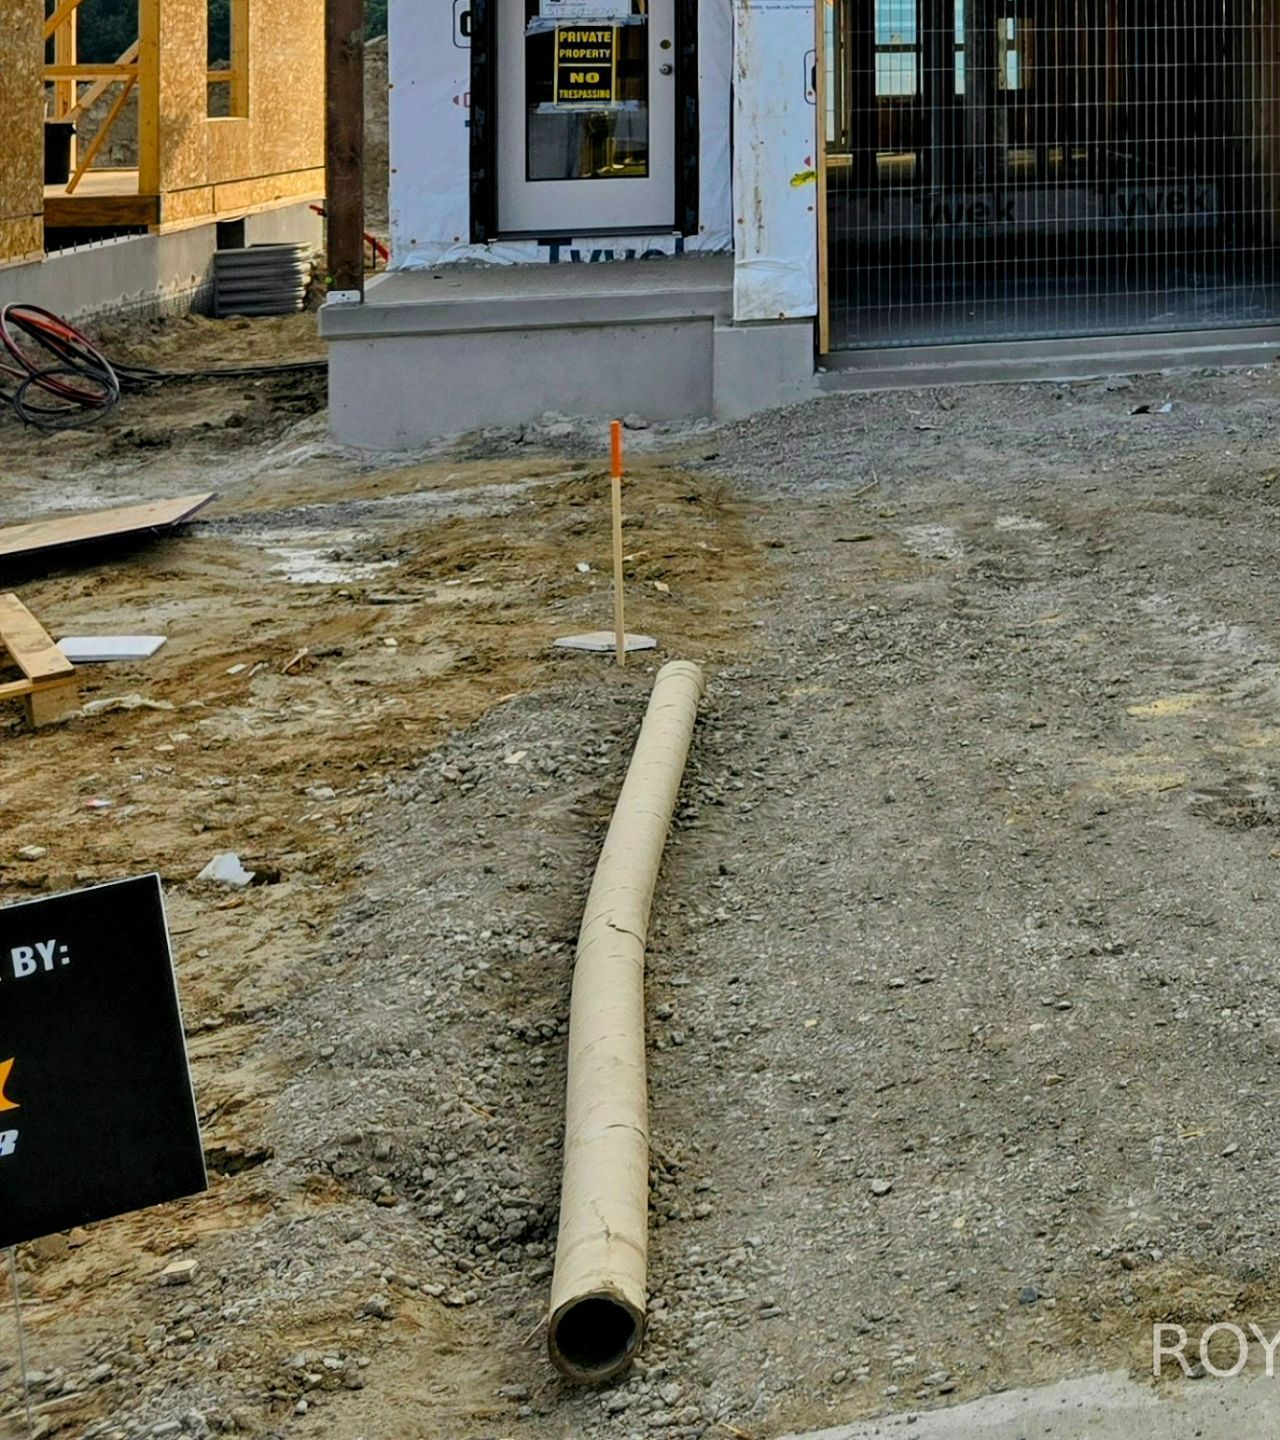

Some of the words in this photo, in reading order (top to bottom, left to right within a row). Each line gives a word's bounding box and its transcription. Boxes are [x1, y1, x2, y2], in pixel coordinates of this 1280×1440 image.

[559, 31, 611, 42] PRIVATE
[559, 49, 611, 58] PROPERTY
[570, 72, 600, 83] NO
[559, 89, 611, 98] TRESPASSING
[11, 939, 71, 978] BY:
